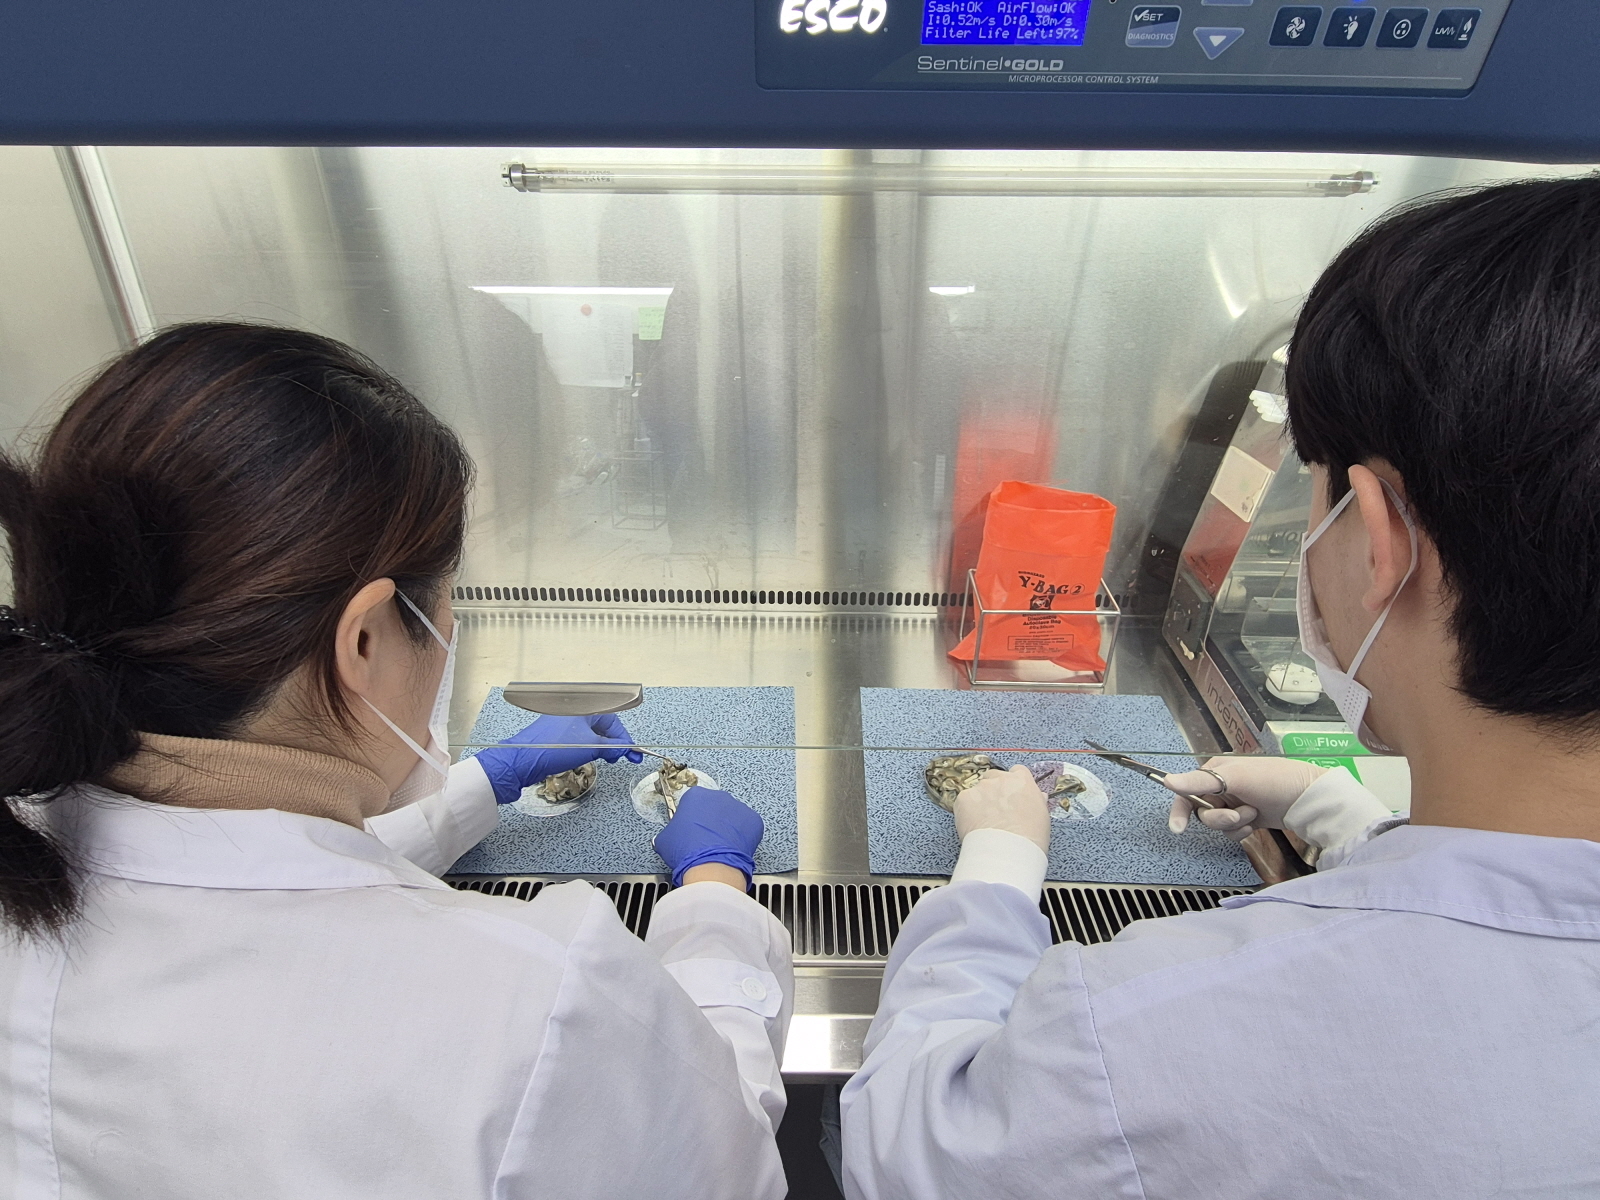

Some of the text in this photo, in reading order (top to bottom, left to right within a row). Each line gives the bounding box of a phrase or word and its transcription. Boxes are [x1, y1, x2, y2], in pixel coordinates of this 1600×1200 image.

[928, 2, 1076, 14] Sash:OK AirFlow:OK
[928, 15, 1073, 27] I:0.52m/s D:0.30m/s
[926, 27, 1079, 40] Filter Life Left:97%
[1008, 74, 1159, 84] MICROPROCESSOR CONTROL SYSTEM
[1019, 575, 1069, 595] Y-BAG
[1292, 736, 1349, 748] DiluFlow
